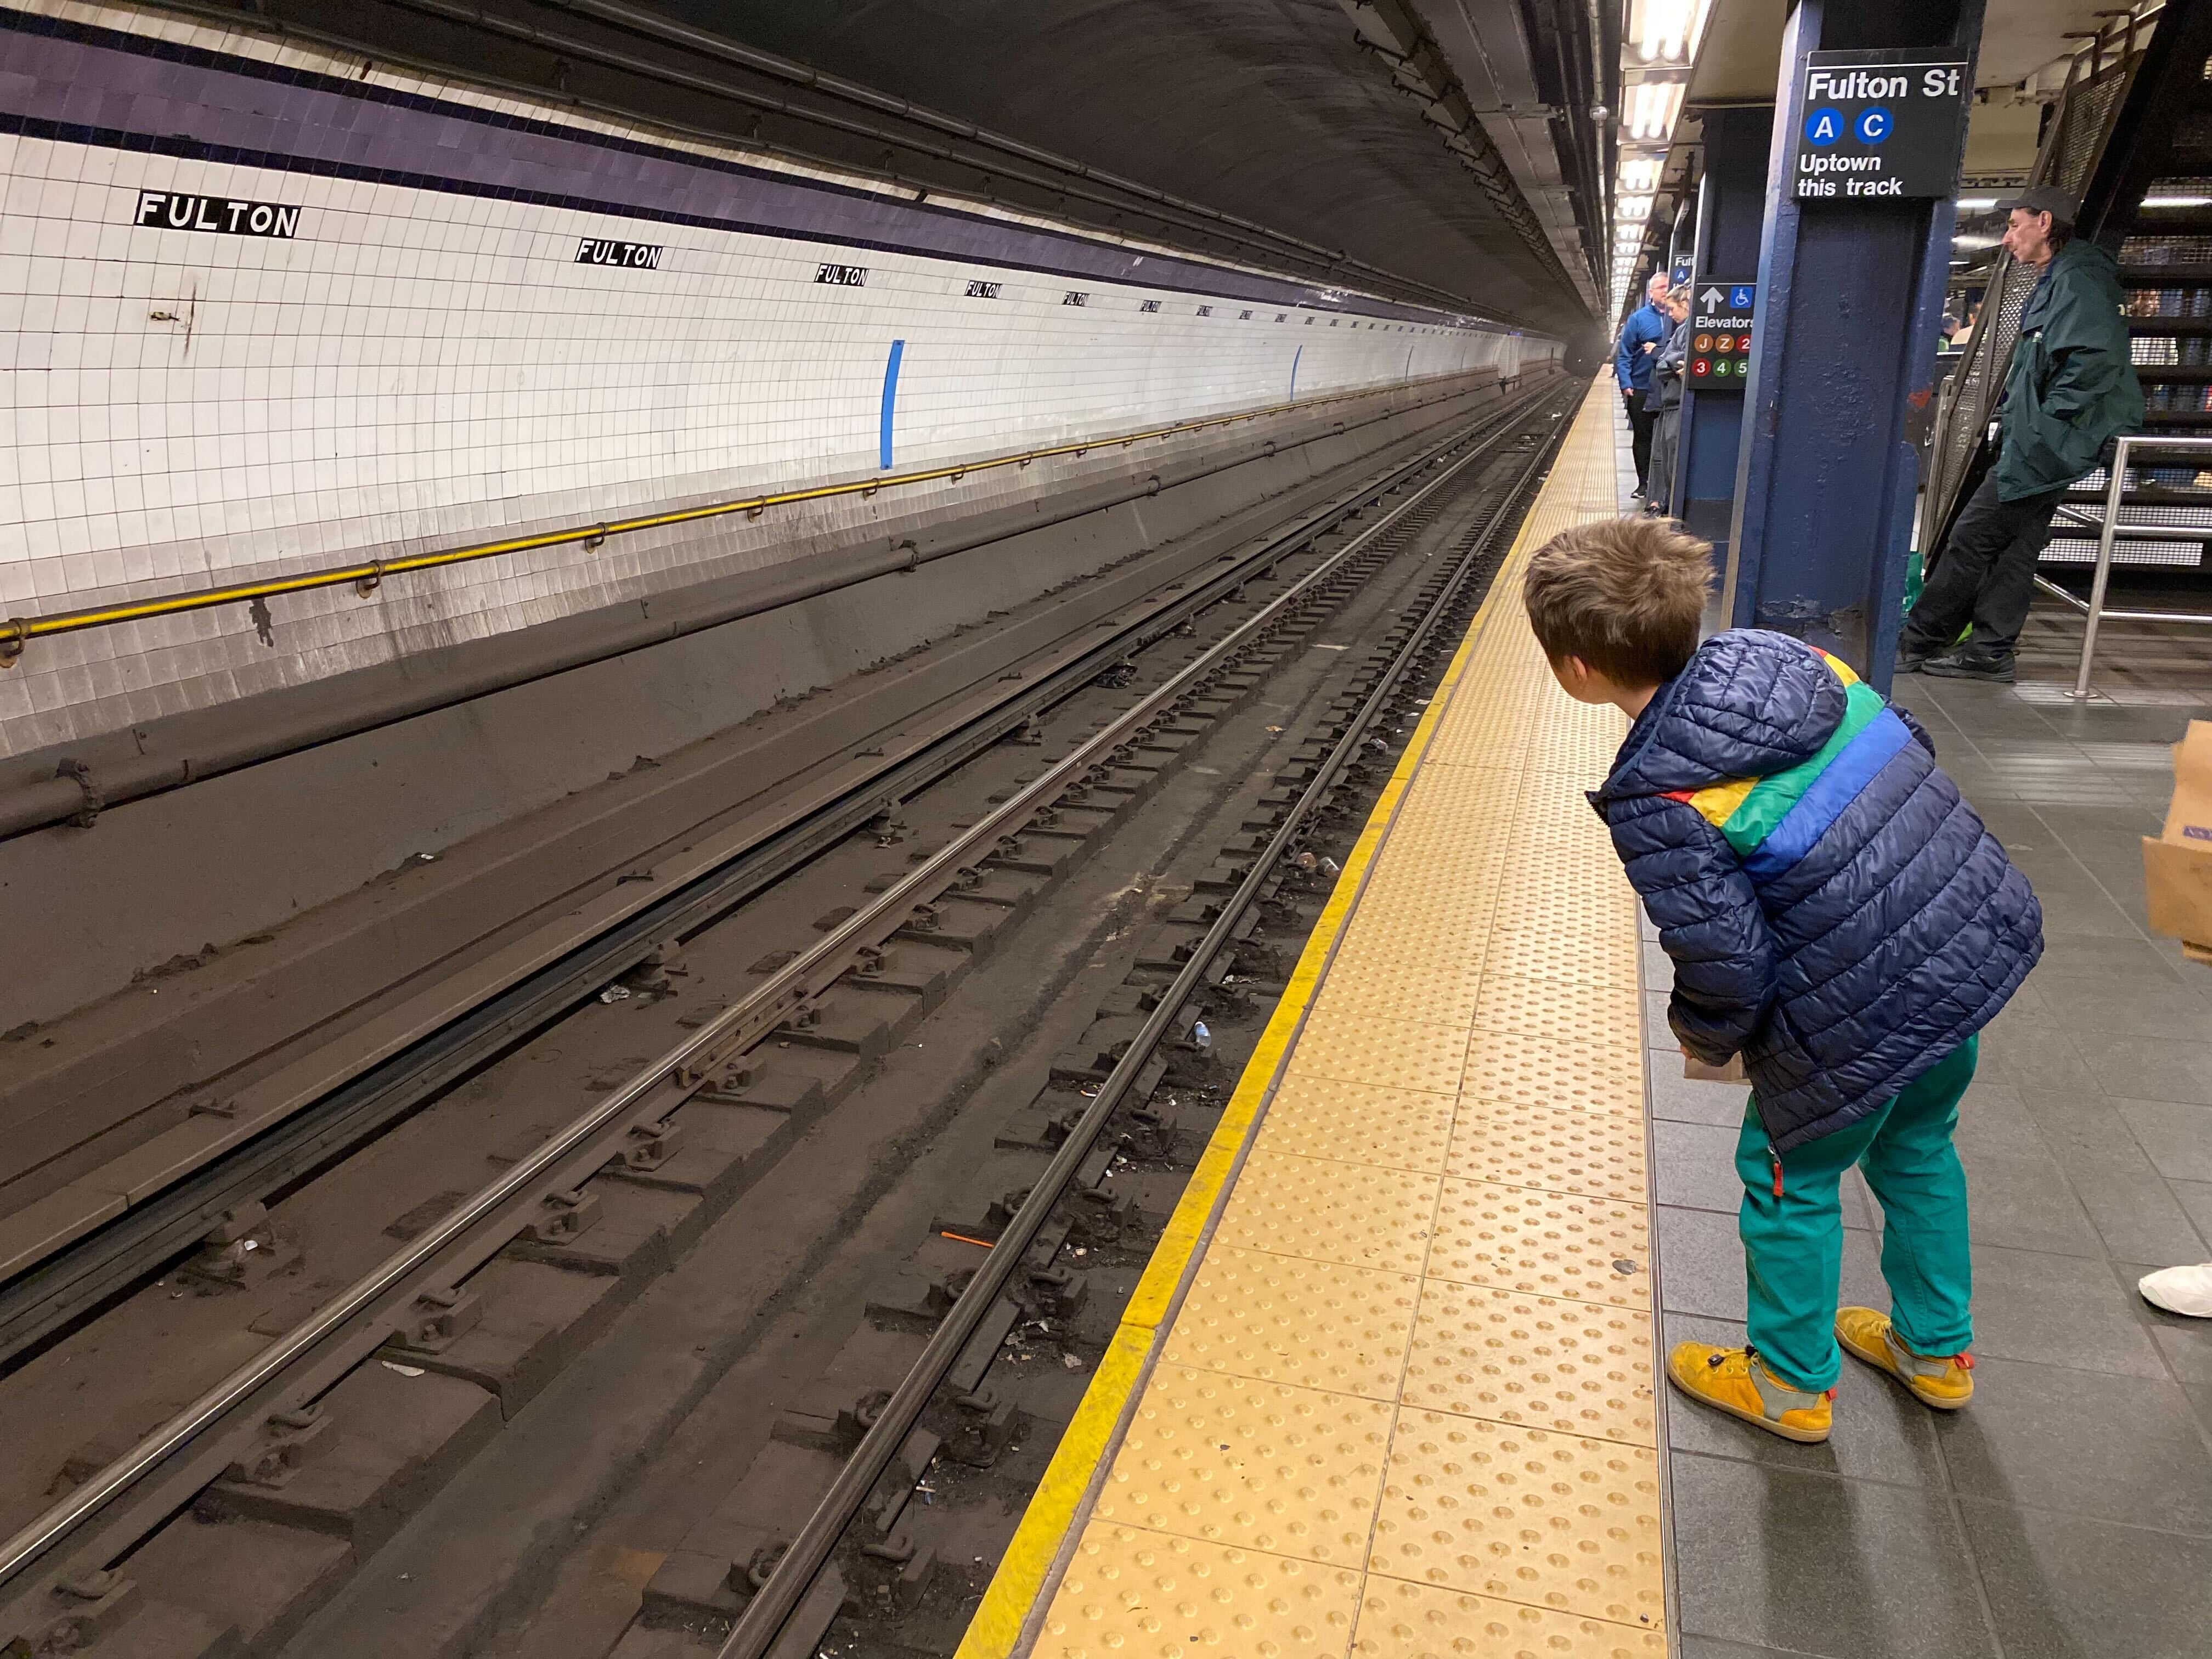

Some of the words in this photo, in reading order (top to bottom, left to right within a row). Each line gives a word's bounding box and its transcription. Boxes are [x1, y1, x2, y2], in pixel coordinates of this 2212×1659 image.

[1808, 71, 1908, 100] Fulton
[1922, 69, 1960, 97] St
[1814, 116, 1834, 138] A
[1863, 114, 1884, 137] C
[1799, 153, 1881, 176] Uptown
[1798, 178, 1836, 196] this
[1846, 177, 1903, 196] track
[136, 193, 298, 237] FULTON
[576, 239, 662, 268] FULTON
[815, 264, 869, 285] FULTON
[1677, 270, 1684, 279] A
[965, 281, 1002, 298] FULTON
[1699, 338, 1708, 349] J
[1720, 338, 1730, 349] Z
[1741, 338, 1750, 349] 2
[1696, 362, 1706, 373] 3
[1717, 363, 1726, 374] 4
[1738, 363, 1747, 374] 5
